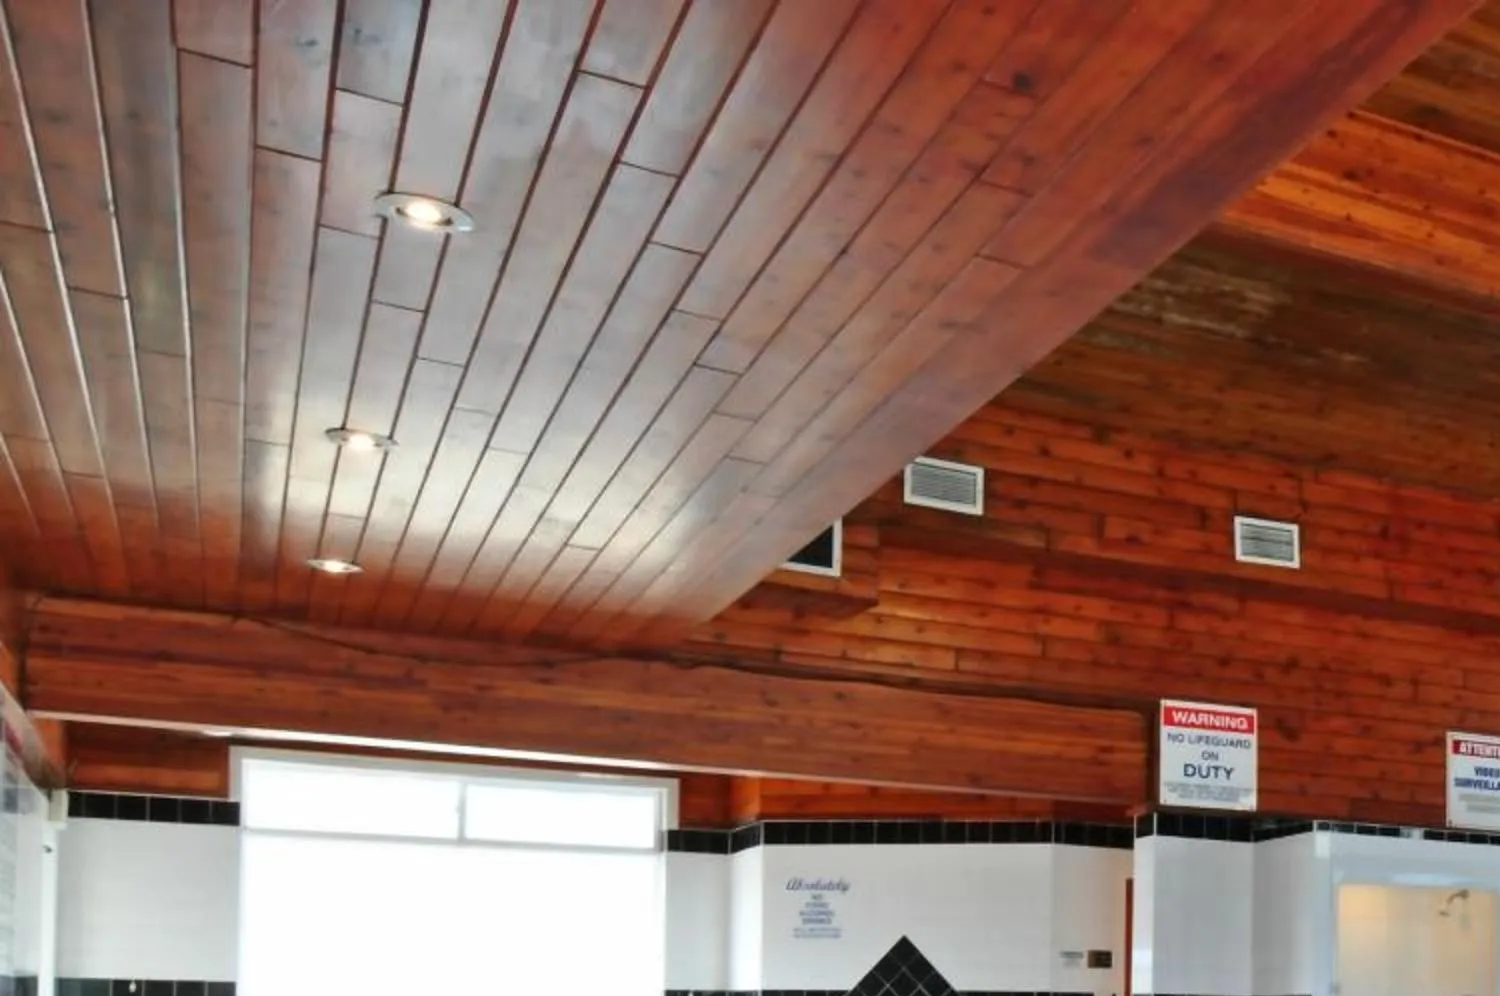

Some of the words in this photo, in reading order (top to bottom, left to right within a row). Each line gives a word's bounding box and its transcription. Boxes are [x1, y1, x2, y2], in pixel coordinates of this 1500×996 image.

[1172, 709, 1249, 730] WARNING
[1167, 733, 1185, 743] NO
[1188, 734, 1251, 749] LIFEGUARD
[1201, 751, 1219, 761] ON
[1183, 763, 1235, 781] DUTY
[1474, 766, 1500, 778] VIDEO
[785, 876, 851, 895] Absolutely
